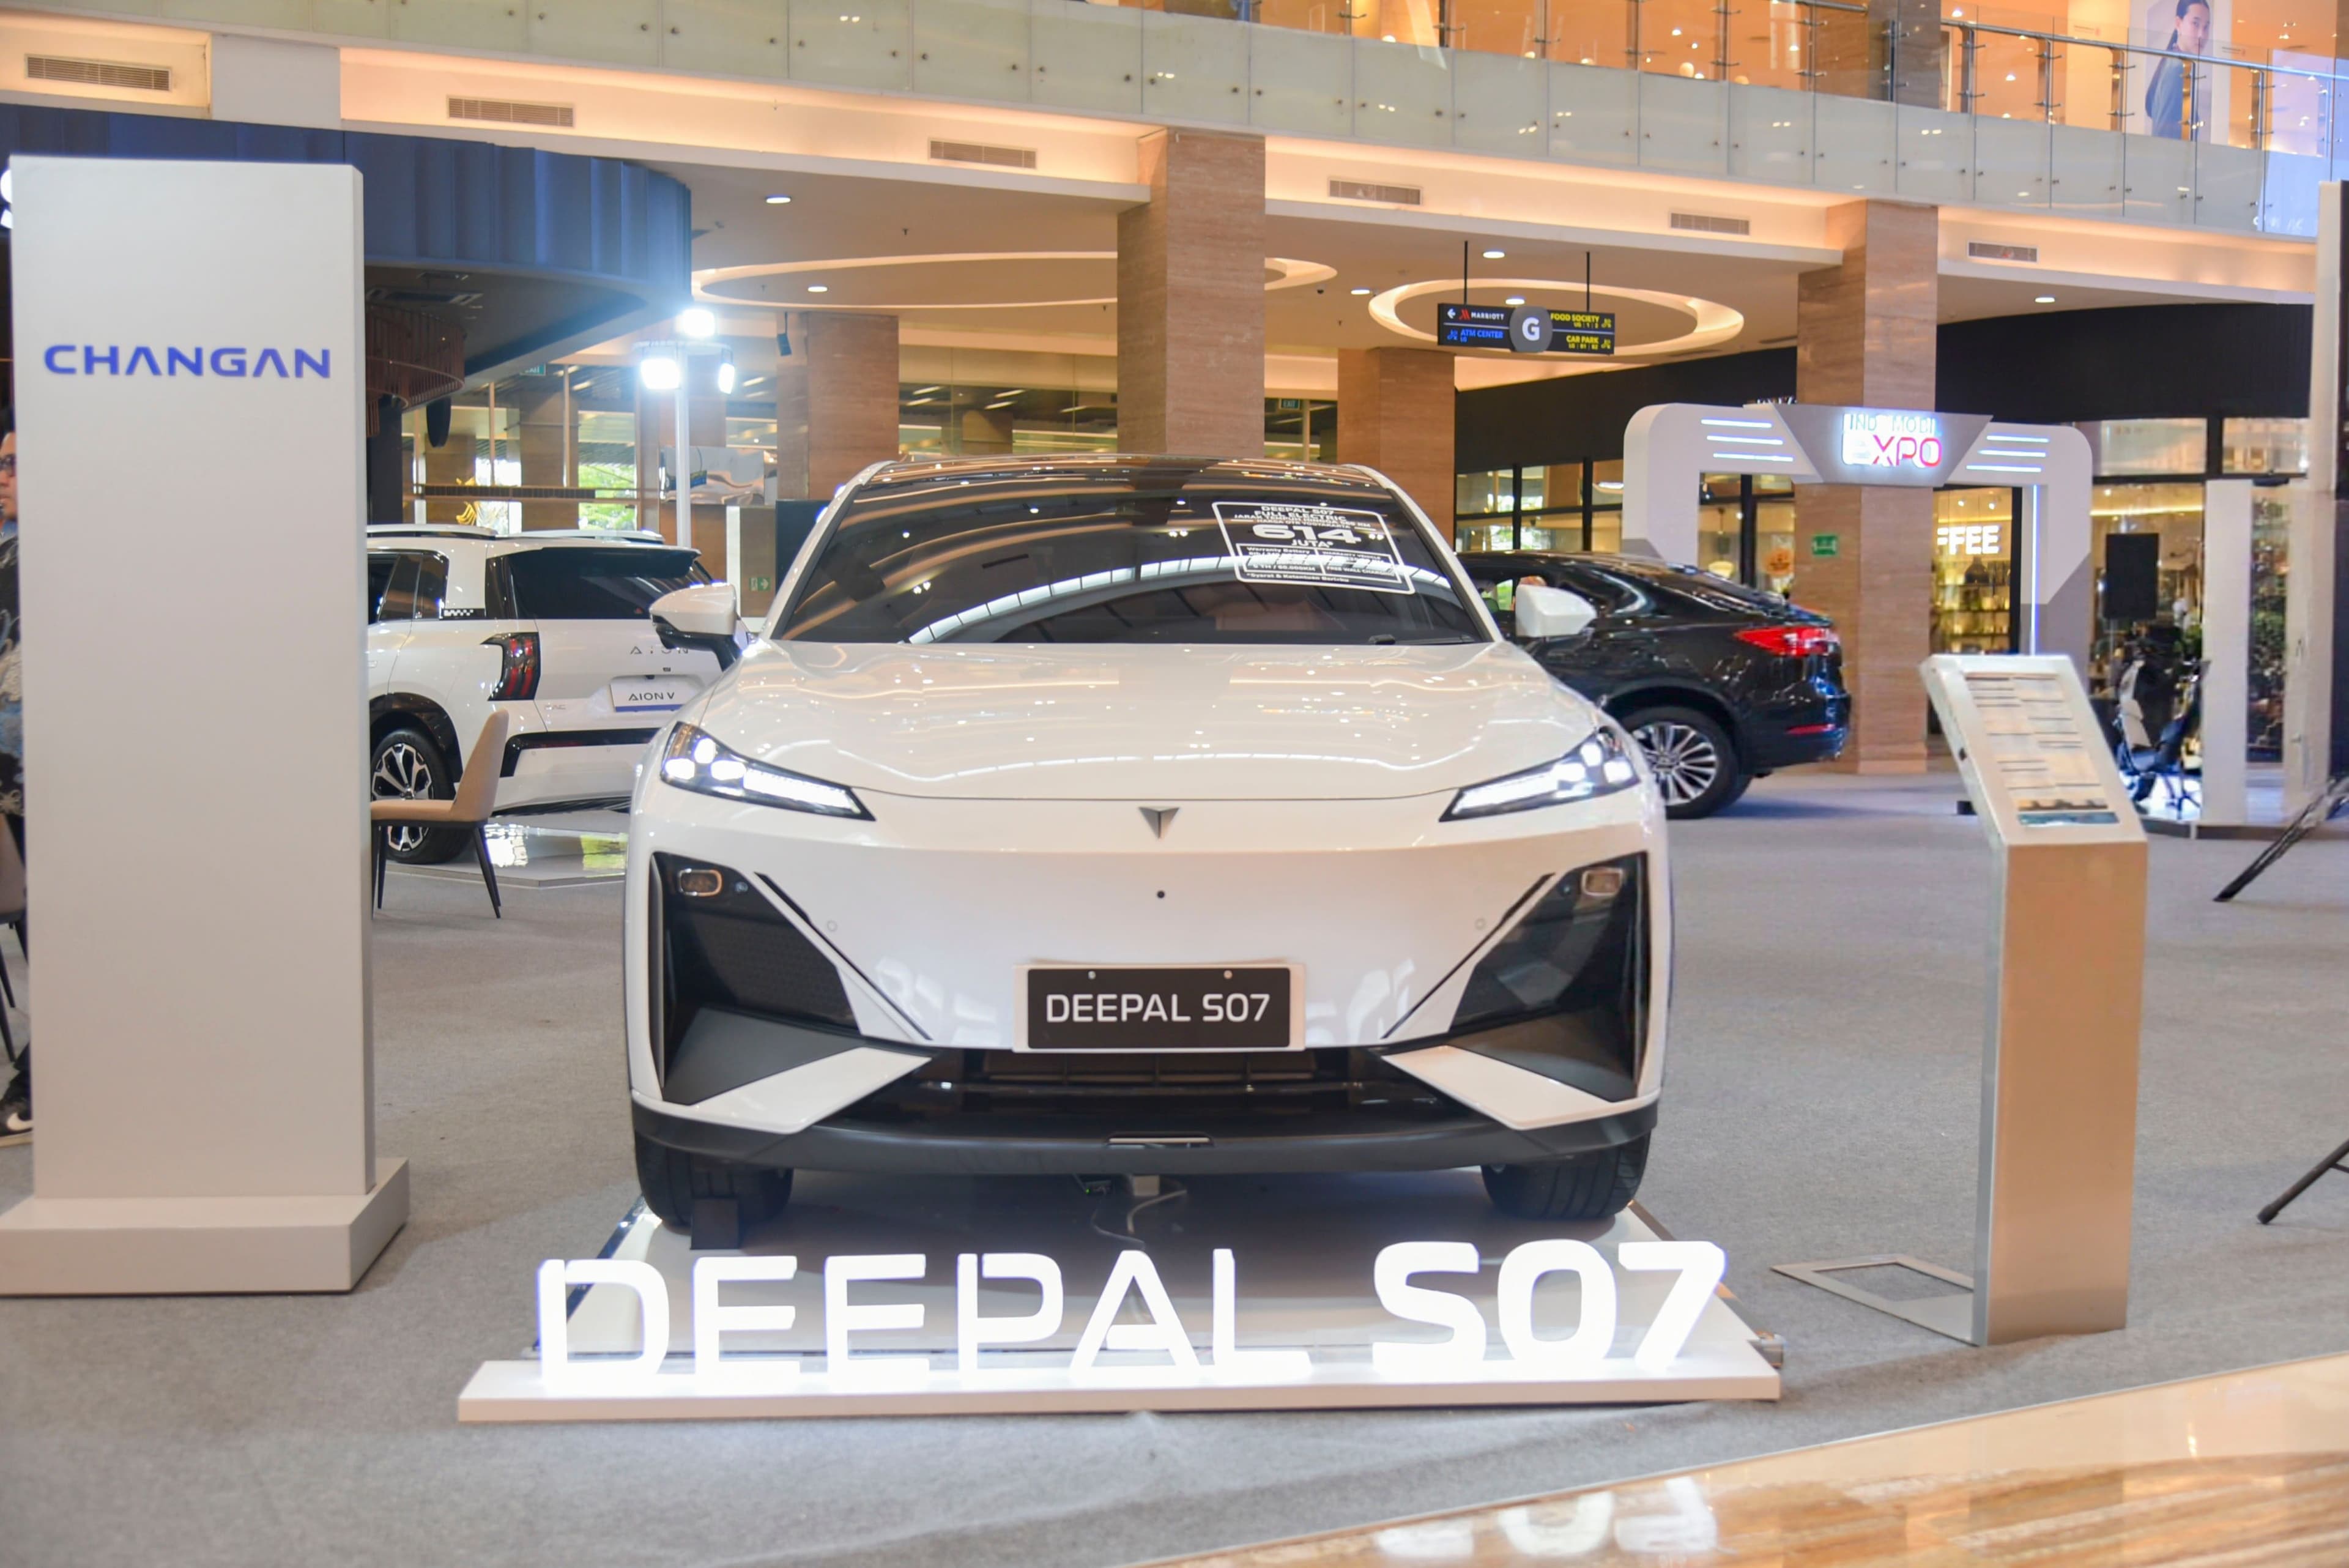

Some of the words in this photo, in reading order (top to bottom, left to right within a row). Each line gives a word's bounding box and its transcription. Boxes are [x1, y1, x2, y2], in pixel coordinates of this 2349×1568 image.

[1471, 311, 1504, 320] MARRIOTT
[1550, 313, 1571, 321] FOOD
[1572, 314, 1600, 322] SOCIETY
[1460, 328, 1476, 337] ATM
[1477, 329, 1504, 339] CENTER
[1522, 317, 1540, 341] G
[44, 345, 330, 379] CHANGAN
[1287, 513, 1346, 522] ELECTRIC
[1252, 524, 1362, 544] 614
[628, 693, 664, 701] AION
[1046, 994, 1191, 1022] DEEPAL
[1202, 993, 1270, 1022] S07
[537, 1249, 1311, 1390] DEEPAL
[1372, 1241, 1727, 1380] S07
